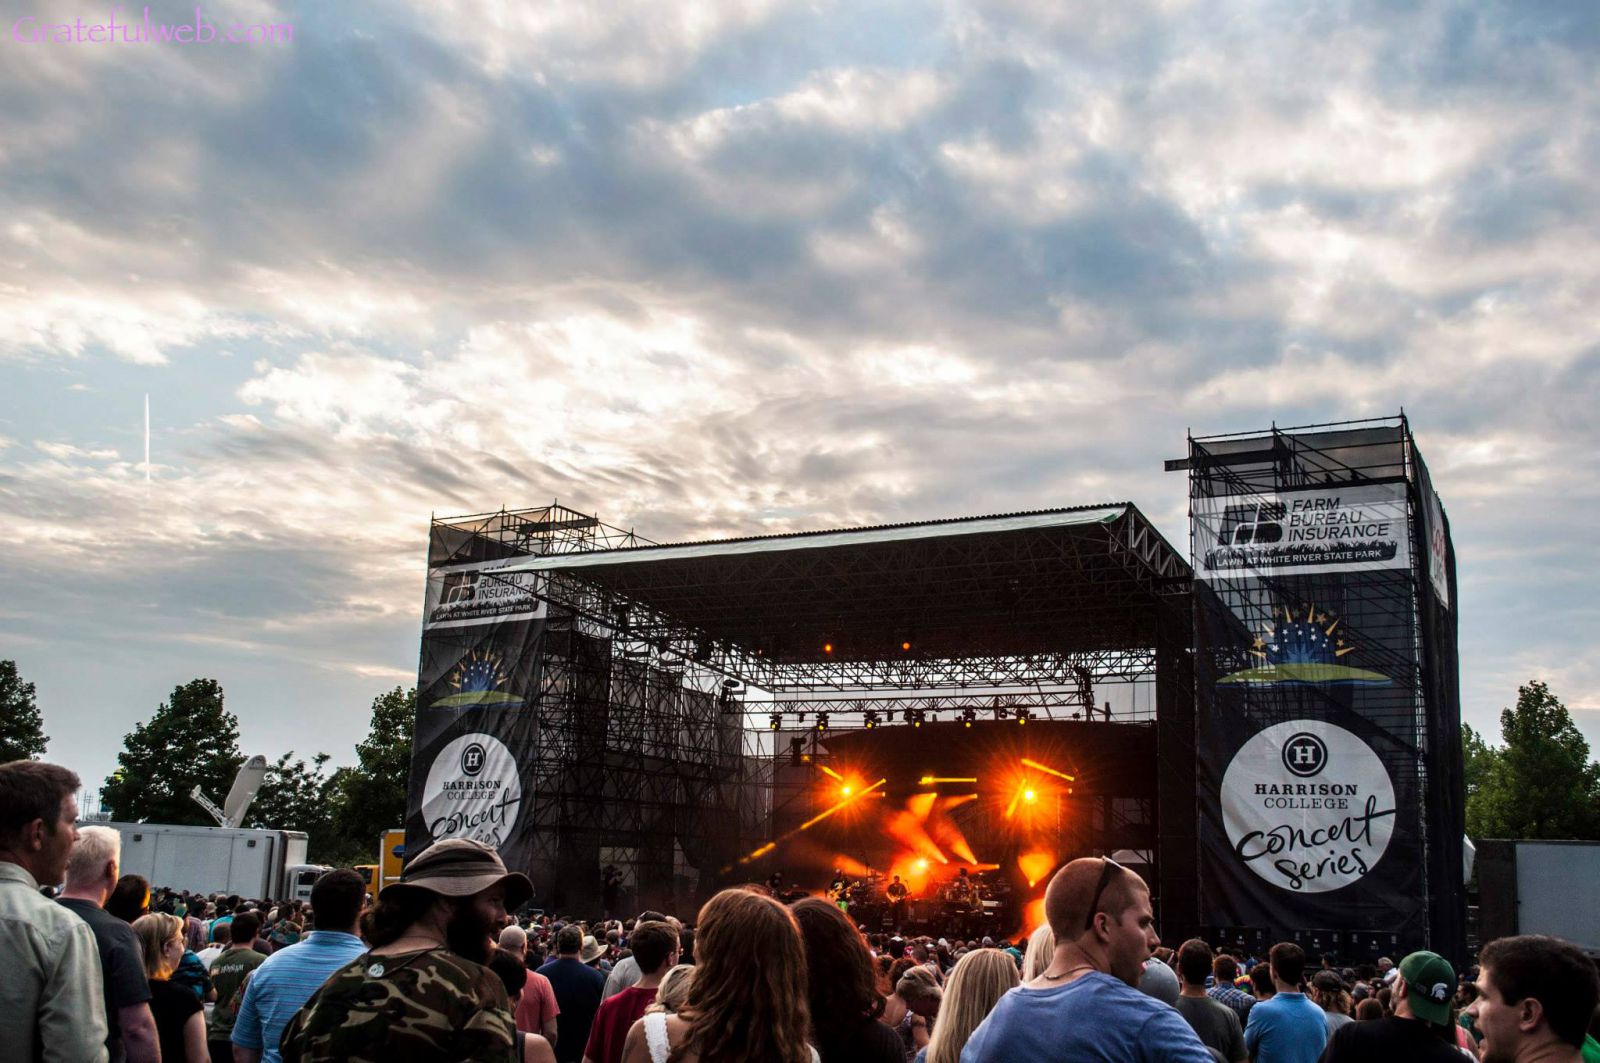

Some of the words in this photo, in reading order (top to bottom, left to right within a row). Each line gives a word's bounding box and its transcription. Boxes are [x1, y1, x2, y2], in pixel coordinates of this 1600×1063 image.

[1292, 498, 1340, 512] FARM
[1290, 511, 1362, 527] BUREAU
[1288, 523, 1390, 541] INSURANCE
[1217, 558, 1244, 566] LAWN
[1247, 557, 1258, 565] AT
[1260, 555, 1290, 564] WHITE
[1292, 554, 1321, 562] RIVER
[1323, 551, 1353, 560] STATE
[1355, 550, 1382, 558] PARK
[480, 575, 523, 588] BUREAU
[1293, 746, 1315, 764] H
[442, 780, 501, 790] HARRISON
[1254, 783, 1358, 796] HARRISON
[447, 790, 496, 800] COLLEGE
[1264, 797, 1348, 810] COLLEGE
